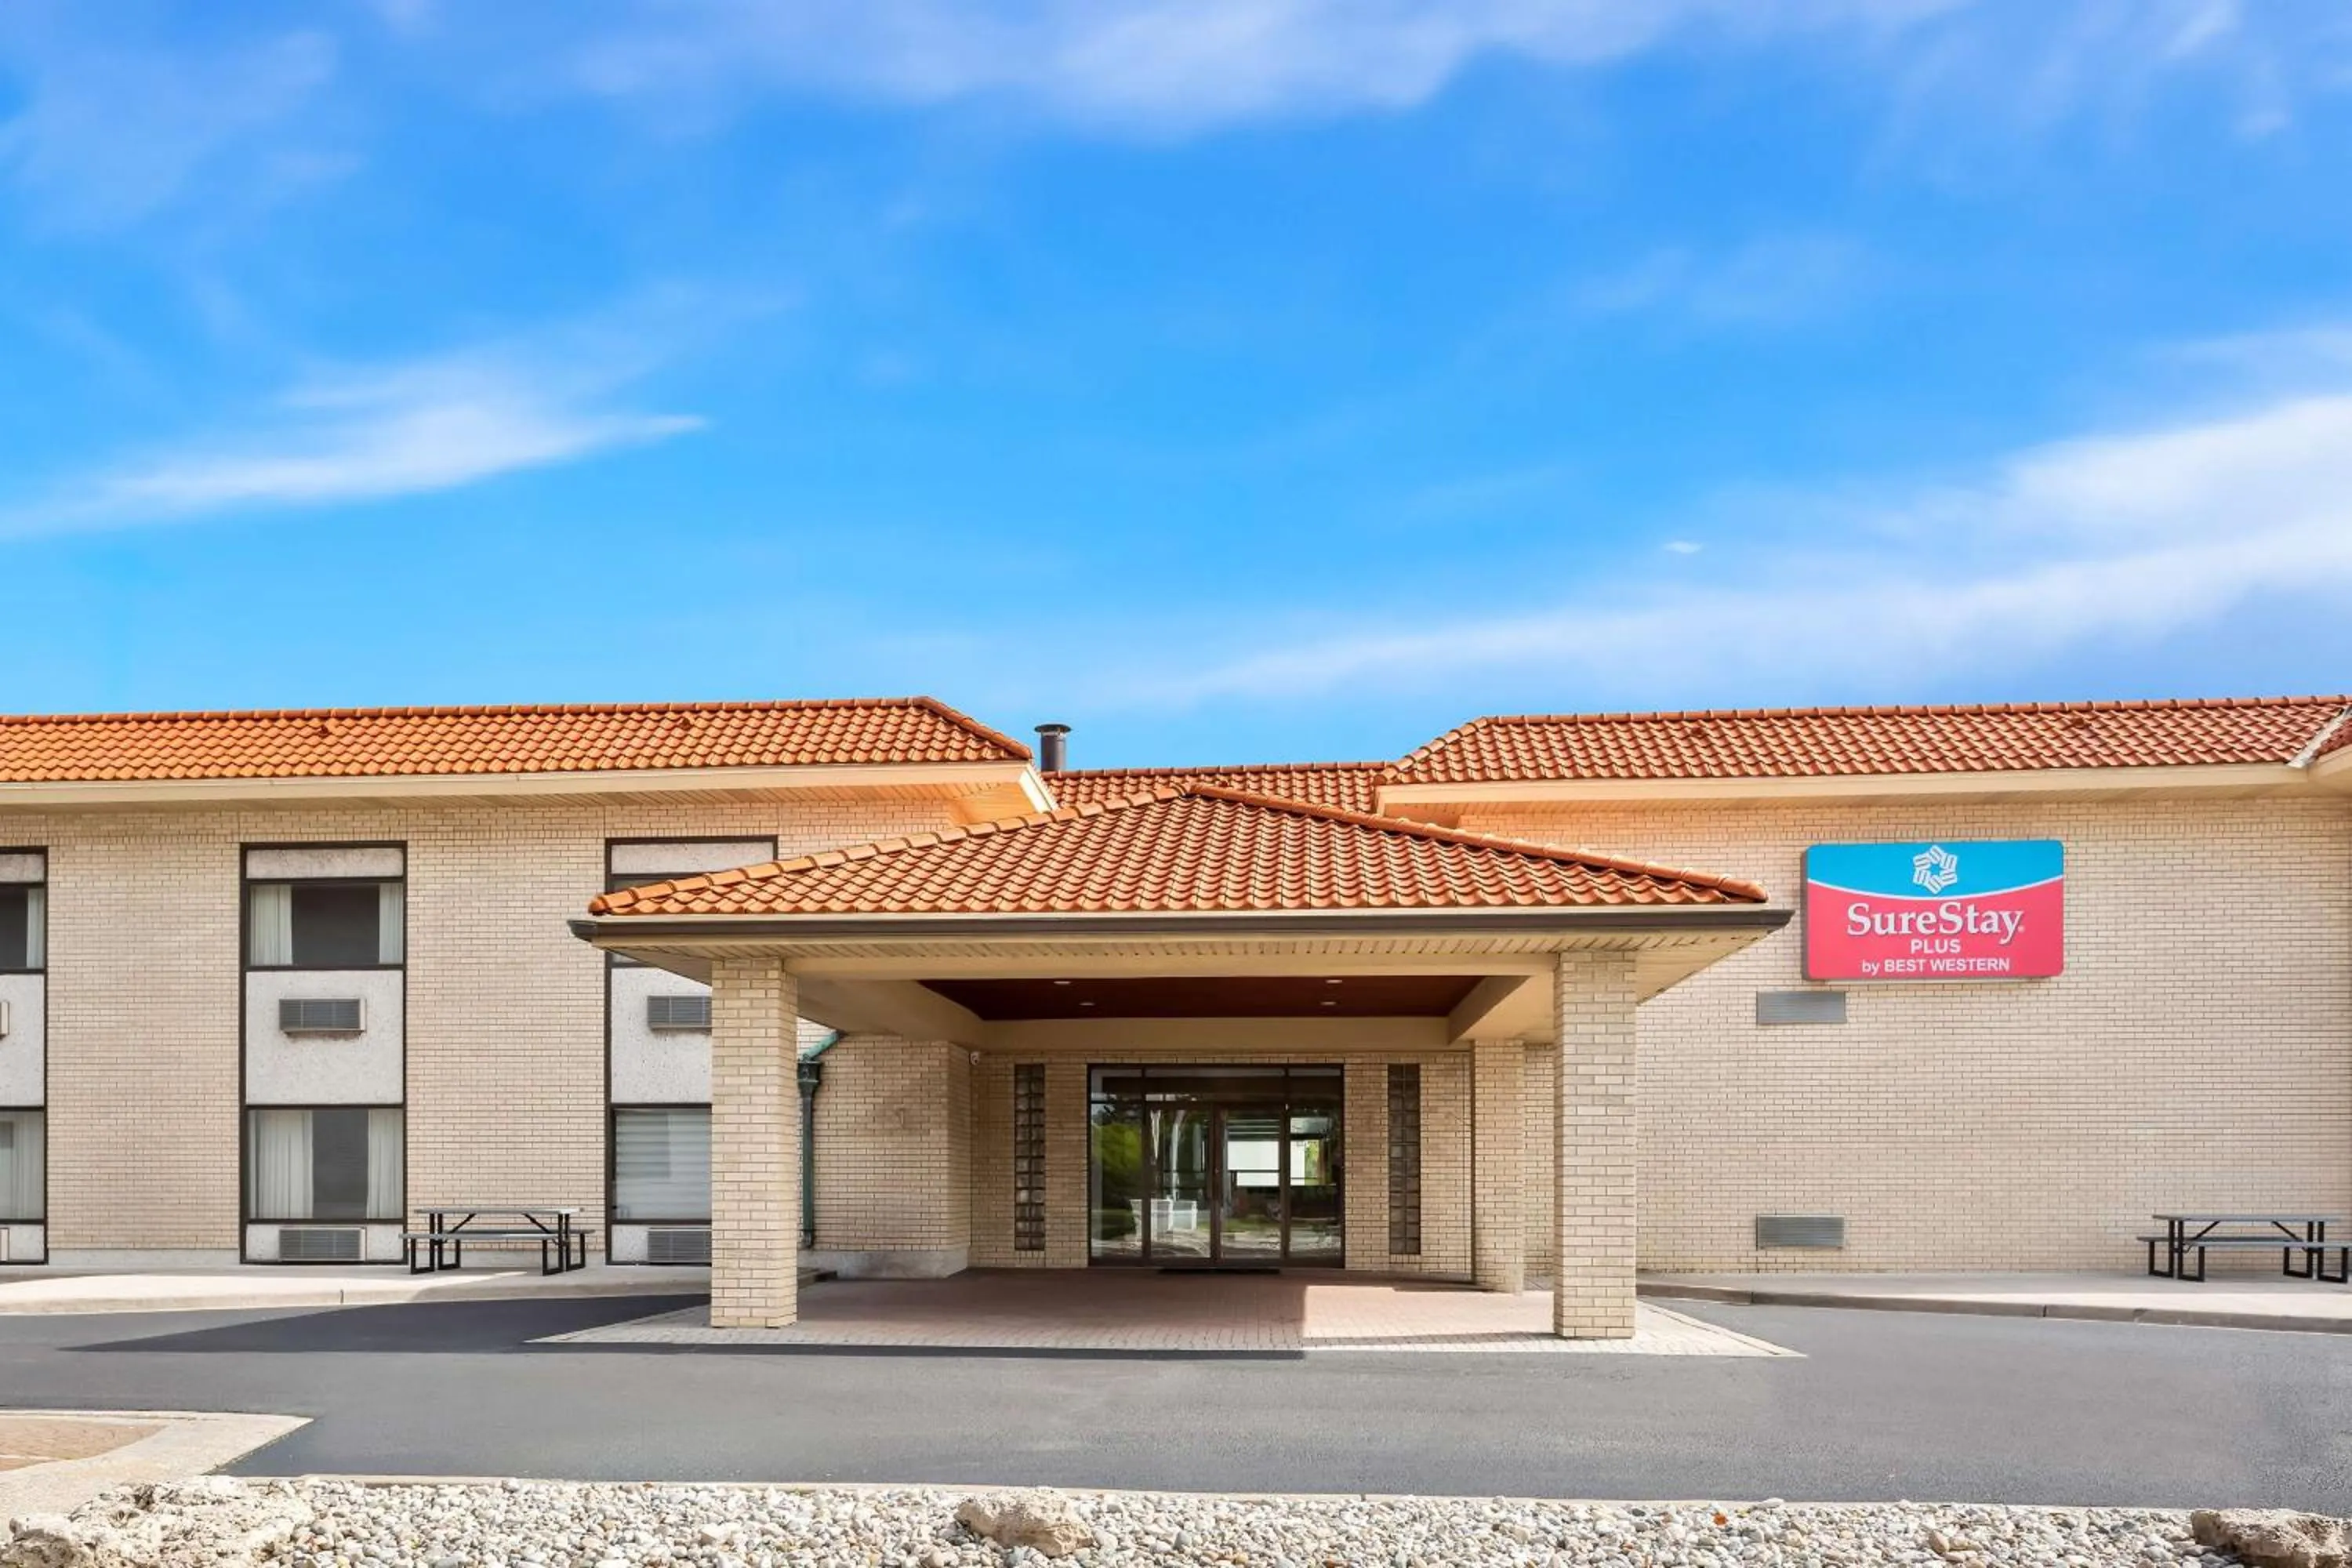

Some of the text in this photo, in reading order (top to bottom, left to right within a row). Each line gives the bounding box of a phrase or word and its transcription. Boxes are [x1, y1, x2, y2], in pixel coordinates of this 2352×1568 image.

[1847, 902, 2023, 944] SureStay
[1911, 939, 1961, 954] PLUS
[1861, 957, 2010, 975] by BEST WESTERN
